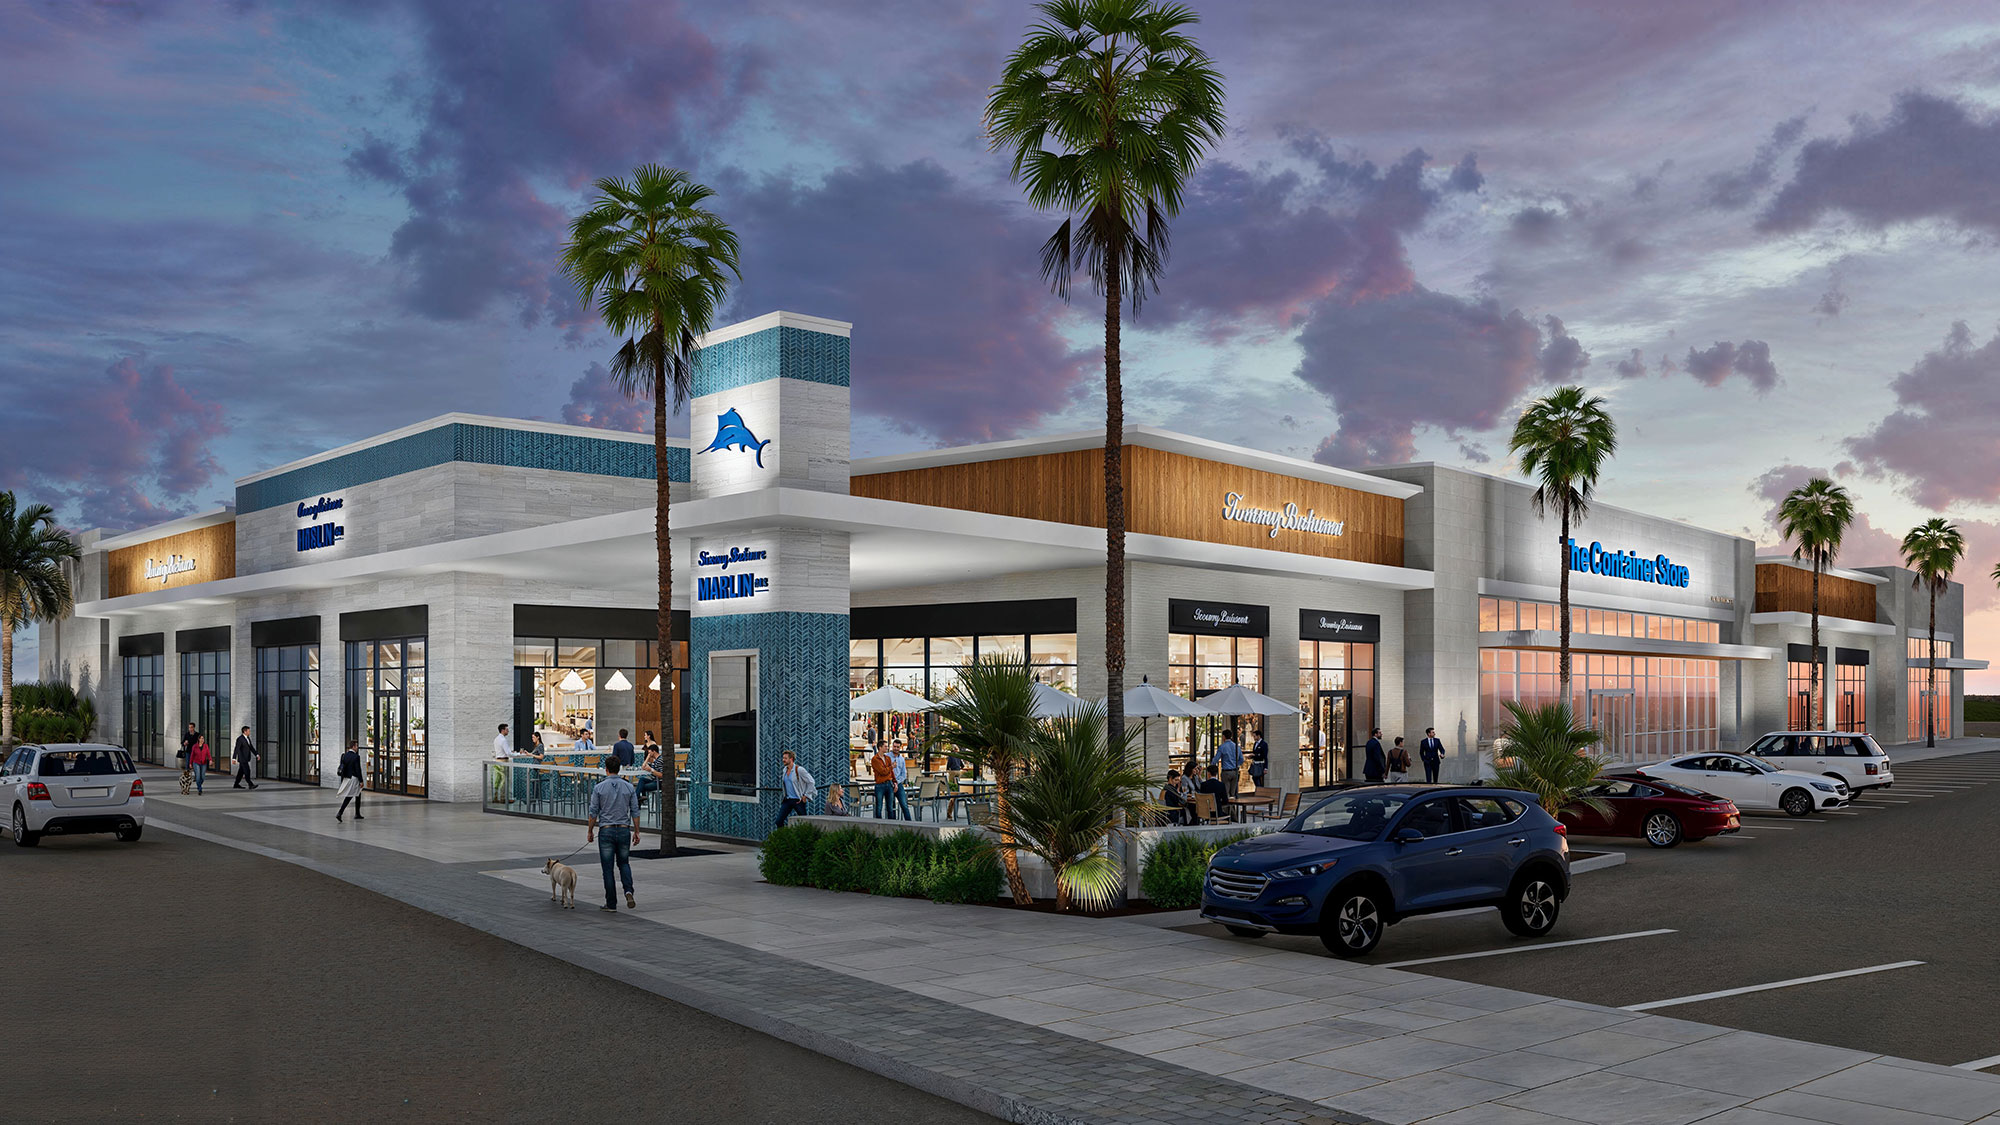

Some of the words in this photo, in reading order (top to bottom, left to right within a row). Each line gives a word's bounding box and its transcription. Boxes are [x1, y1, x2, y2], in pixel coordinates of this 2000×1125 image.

[1589, 541, 1656, 583] Container
[1656, 554, 1690, 588] Store
[697, 573, 754, 601] MARLIN
